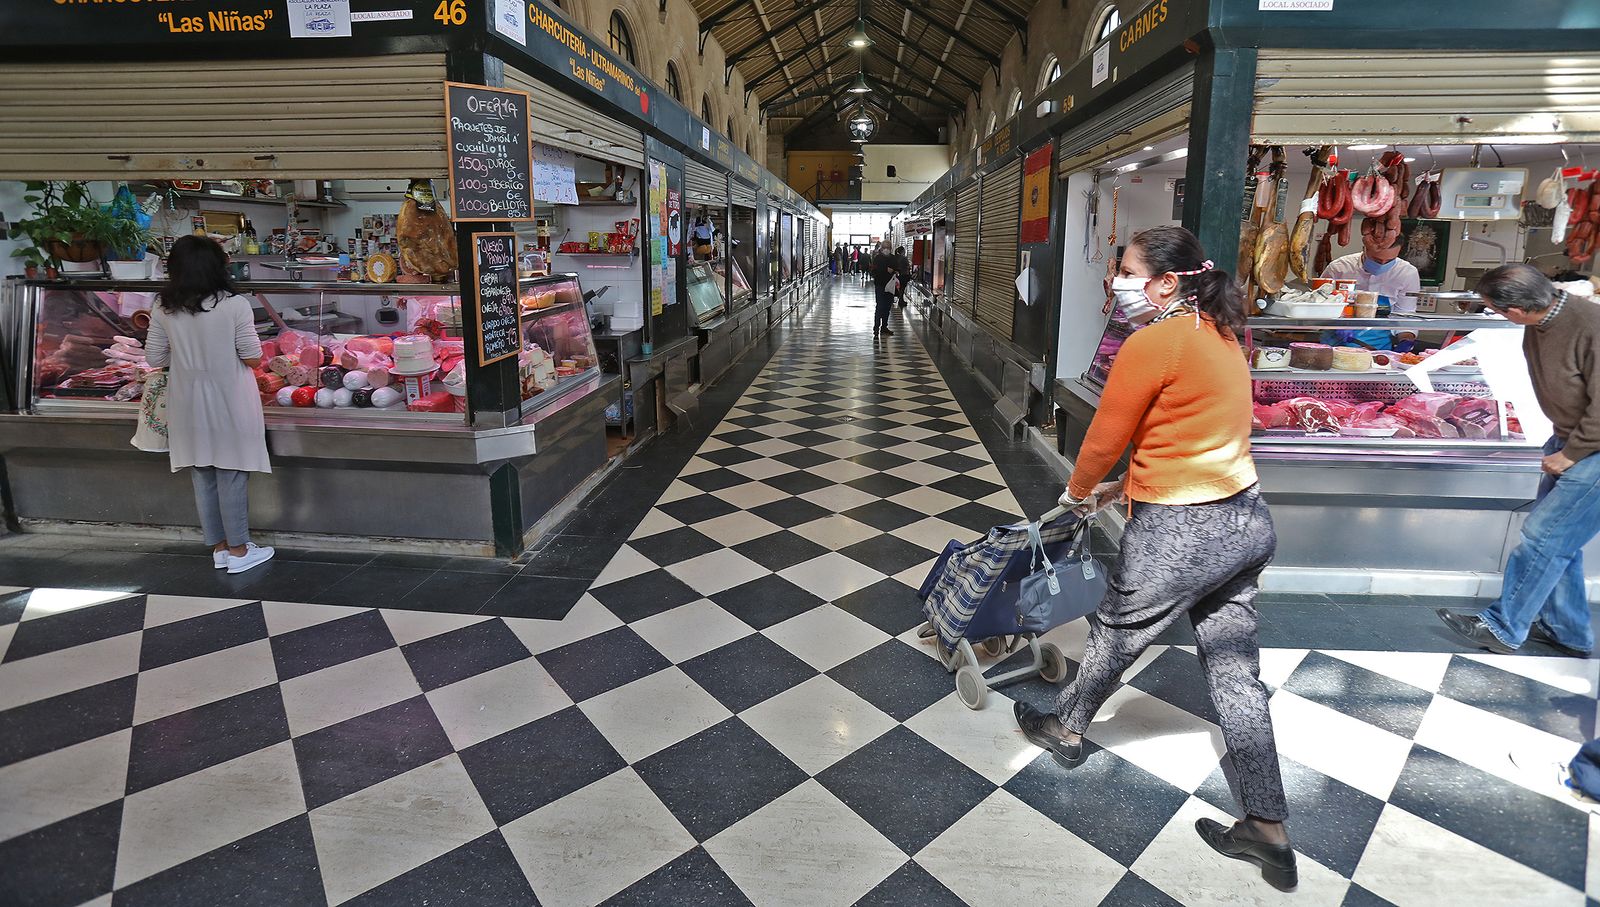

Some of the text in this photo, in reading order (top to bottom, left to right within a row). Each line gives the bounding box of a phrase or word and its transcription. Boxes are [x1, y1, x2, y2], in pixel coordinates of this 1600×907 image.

[353, 10, 410, 20] LOCAL ASOCIADO
[433, 0, 467, 25] 46
[1119, 0, 1168, 52] CARNES
[528, 3, 587, 59] CHARCUTERÍA
[591, 49, 634, 92] ULTRAMARINOS
[466, 95, 519, 120] OFERTA
[450, 116, 508, 134] PAQUETES DE
[458, 155, 517, 178] 150g DUROC
[458, 177, 488, 194] 100g
[458, 197, 528, 216] 100g BELLOTA
